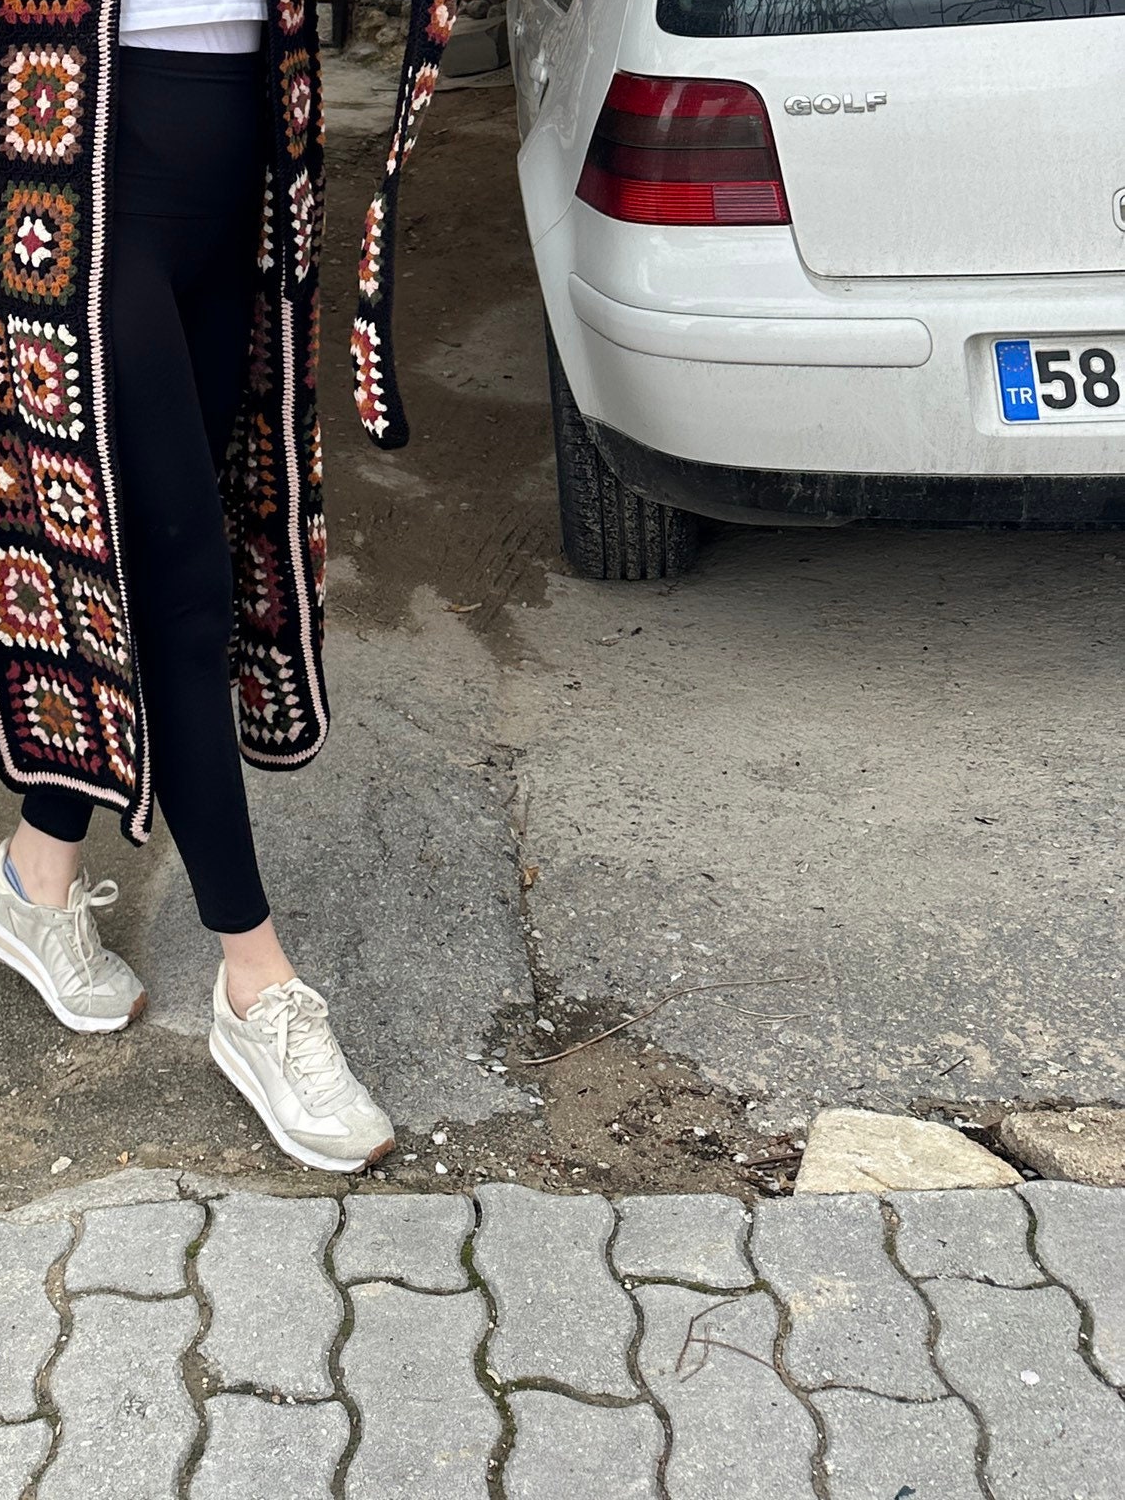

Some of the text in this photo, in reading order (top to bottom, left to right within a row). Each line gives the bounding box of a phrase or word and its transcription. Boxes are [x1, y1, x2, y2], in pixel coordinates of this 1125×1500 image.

[784, 91, 887, 116] GOLF
[1034, 348, 1121, 410] 58
[1006, 387, 1034, 405] TR
